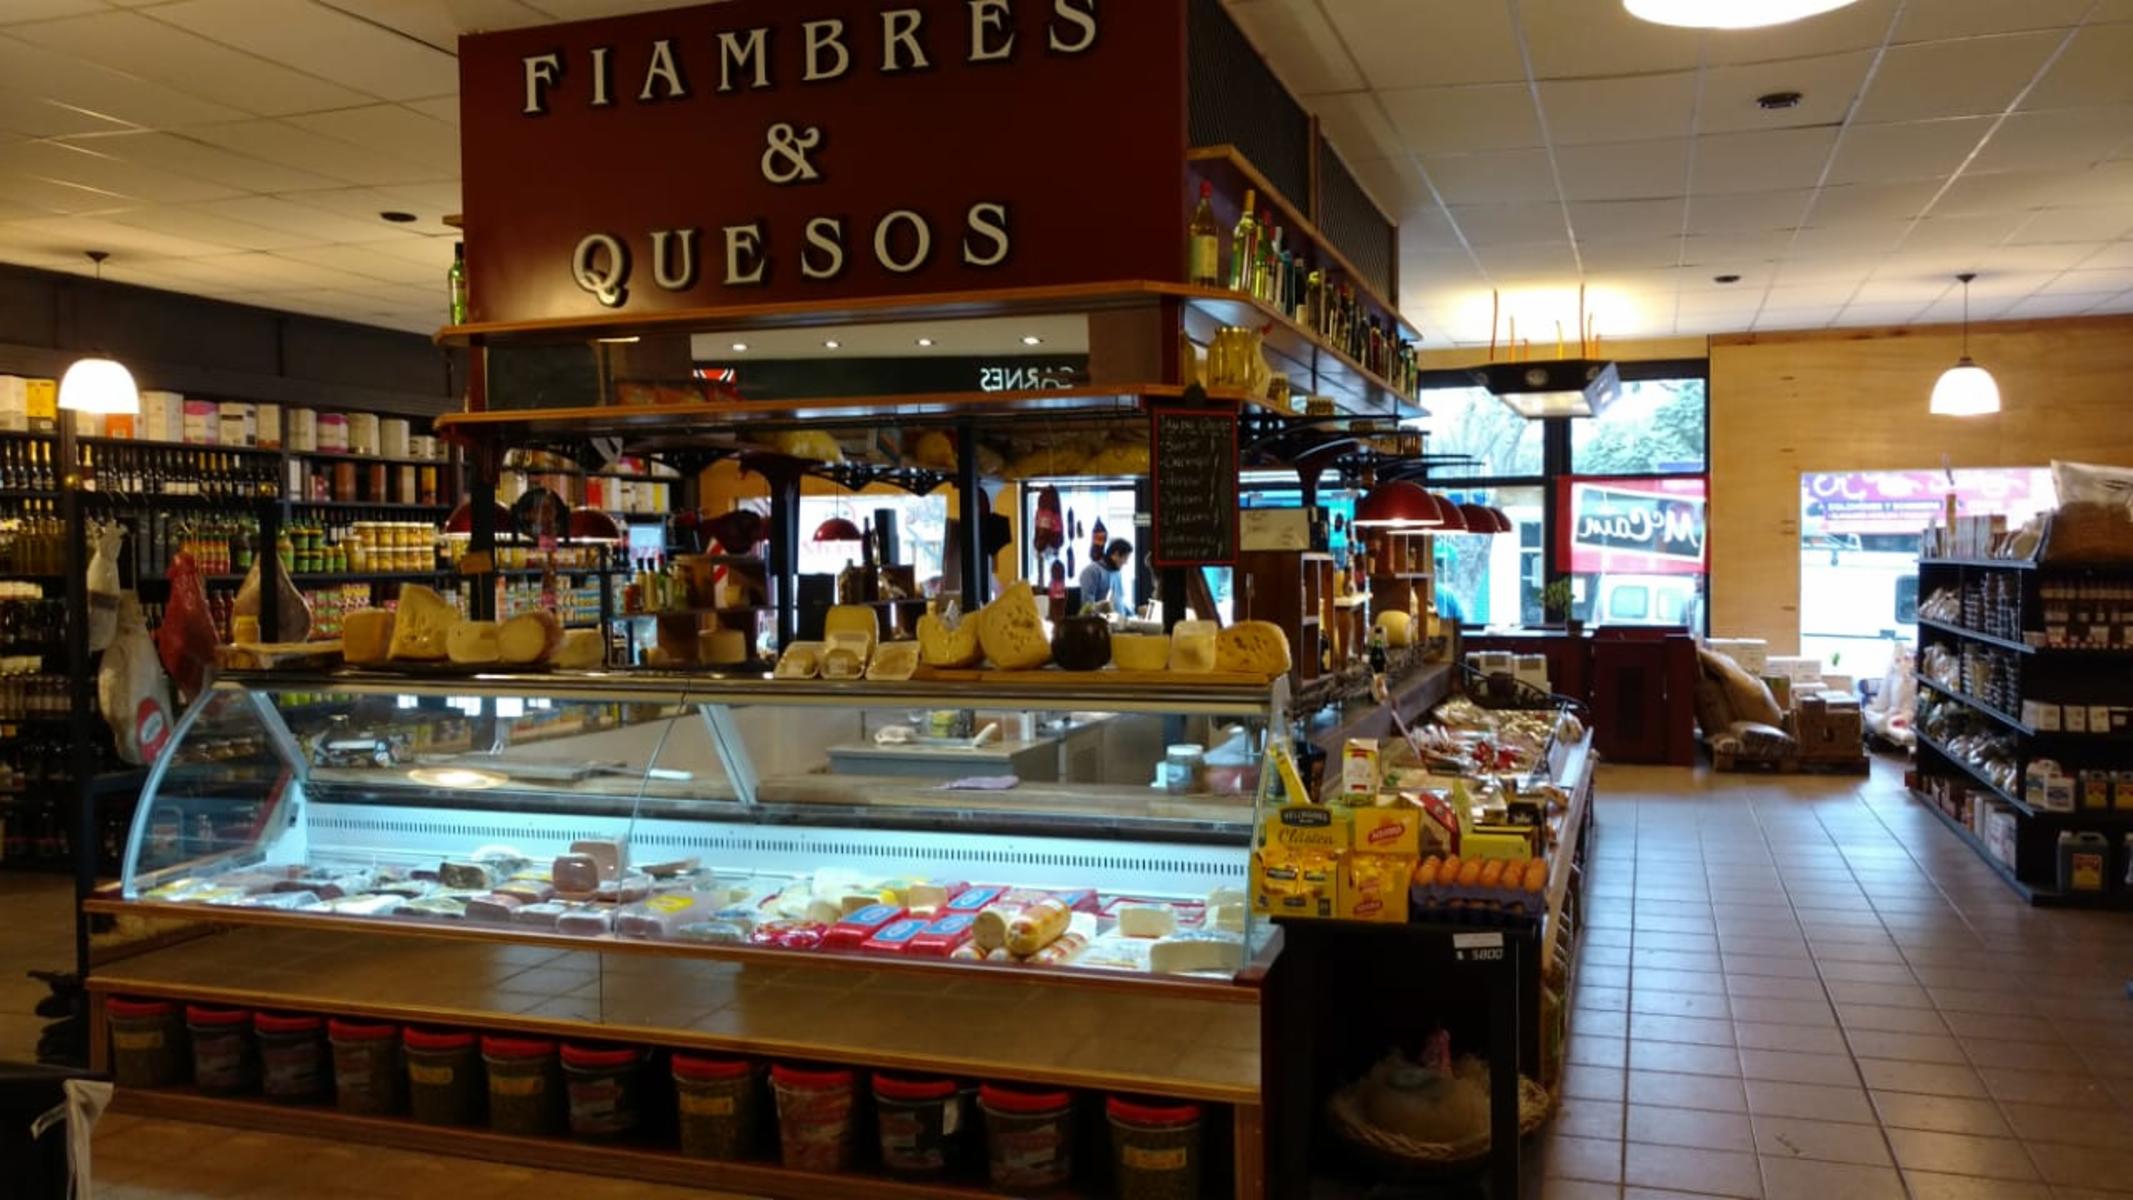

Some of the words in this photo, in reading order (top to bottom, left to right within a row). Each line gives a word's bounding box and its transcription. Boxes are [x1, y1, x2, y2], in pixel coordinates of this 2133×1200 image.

[524, 0, 1098, 114] FIAMBRES
[761, 123, 820, 183] &
[572, 203, 1010, 306] QUESOS
